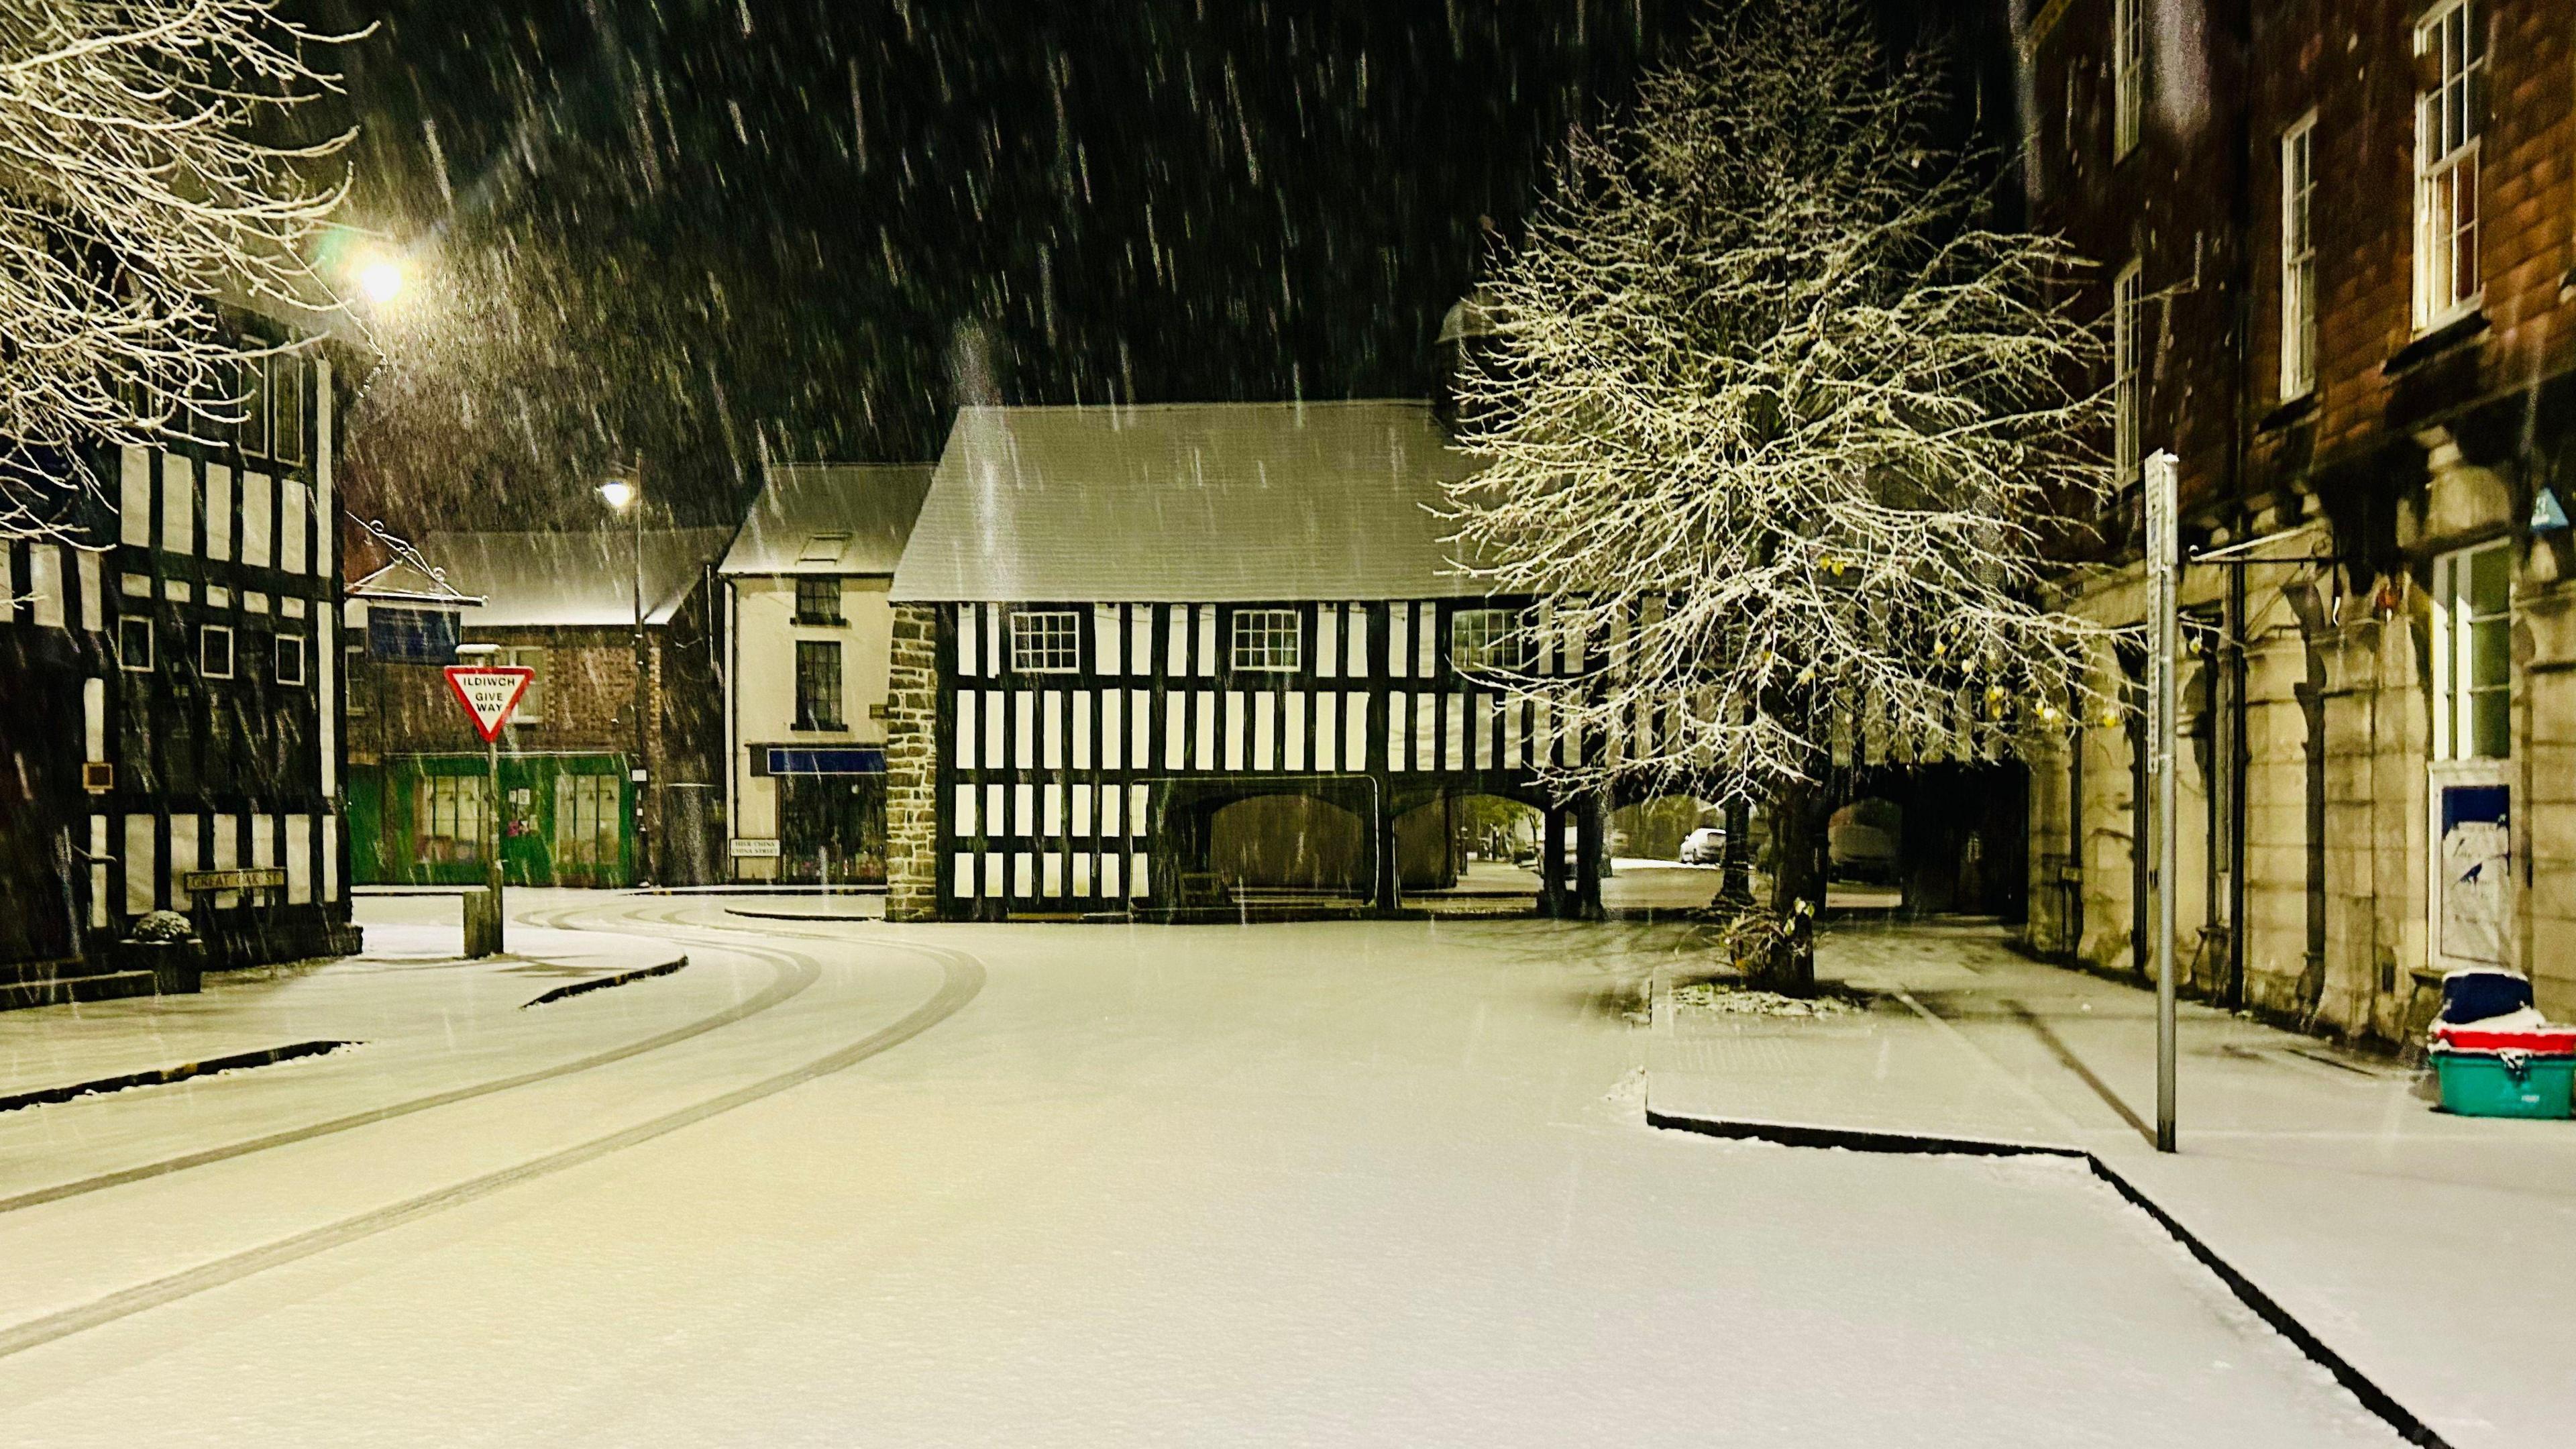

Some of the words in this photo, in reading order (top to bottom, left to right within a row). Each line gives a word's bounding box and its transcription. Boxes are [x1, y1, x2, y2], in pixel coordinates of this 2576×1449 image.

[464, 678, 515, 686] ILDIWCH
[476, 692, 503, 701] GIVE
[476, 703, 502, 711] WAY
[192, 874, 229, 888] GREAT
